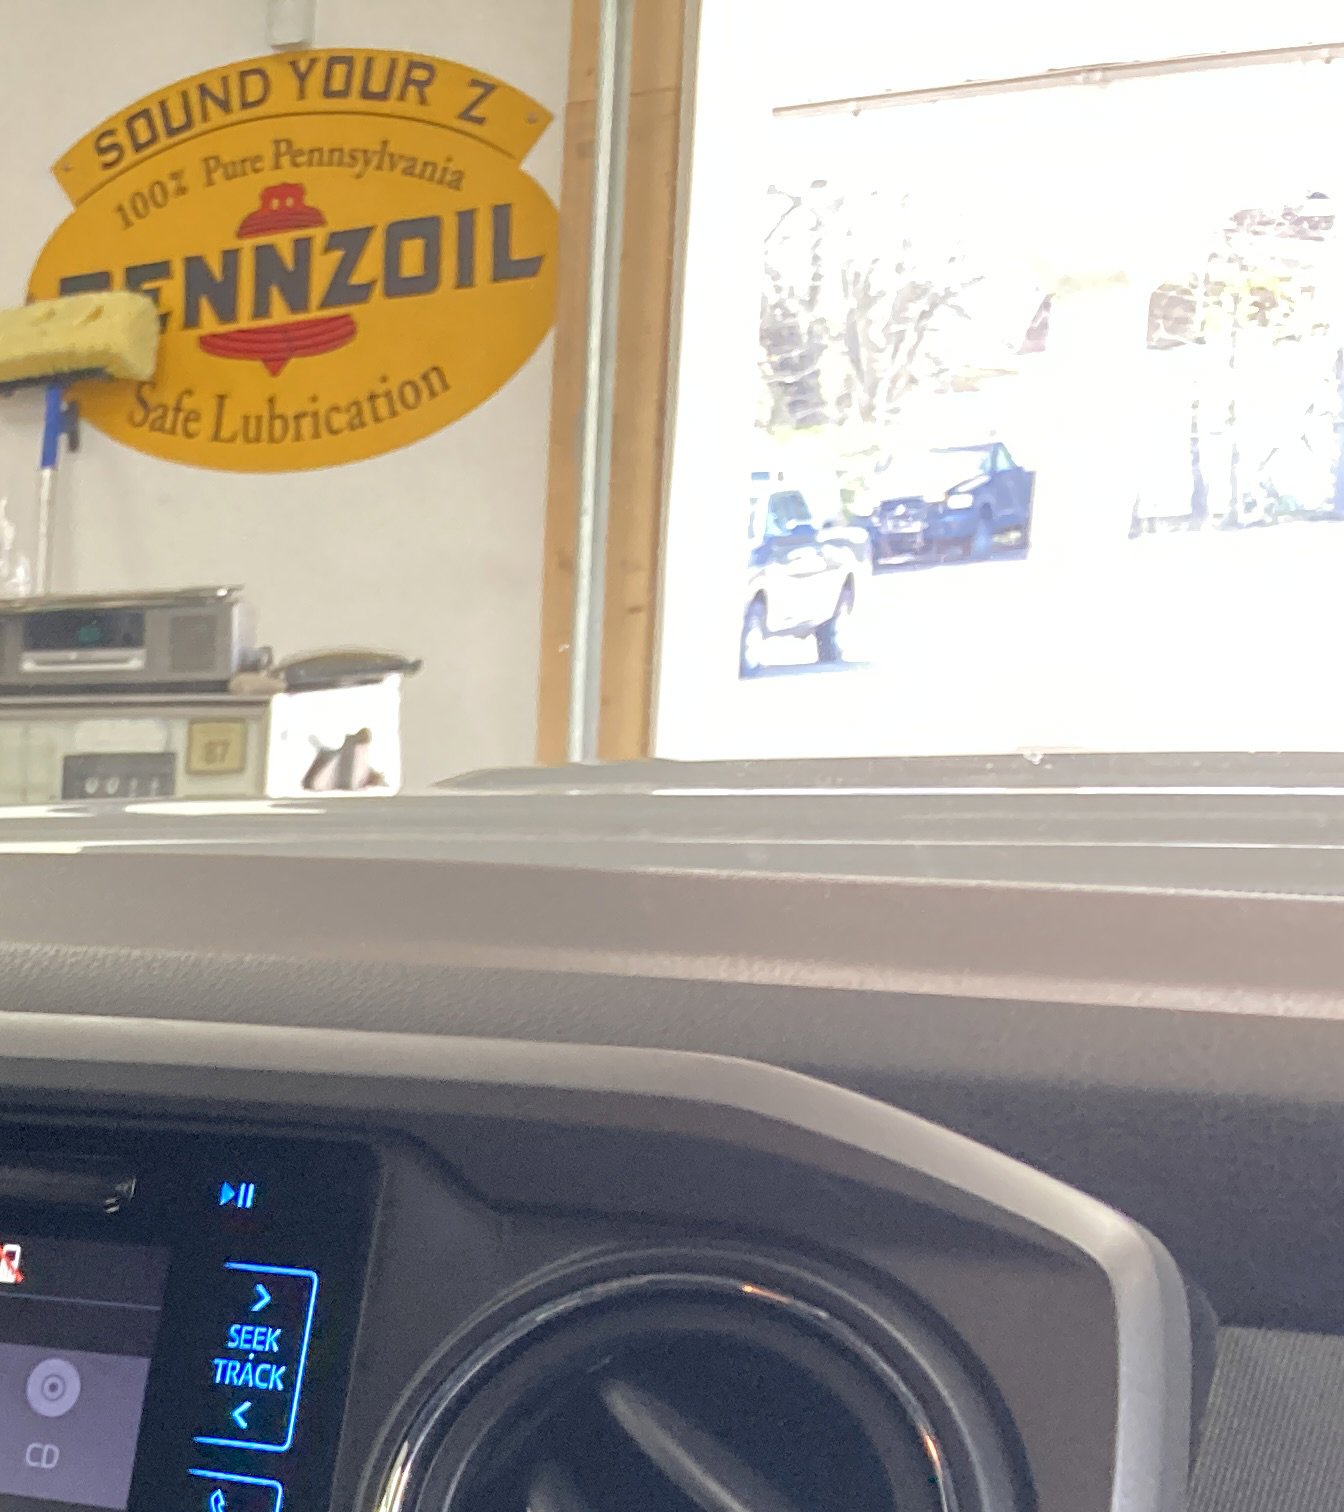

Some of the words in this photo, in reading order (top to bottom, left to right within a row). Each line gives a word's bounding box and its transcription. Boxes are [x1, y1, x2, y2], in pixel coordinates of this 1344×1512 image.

[93, 66, 271, 171] SOUND
[290, 54, 436, 106] YOUR
[458, 78, 498, 126] Z
[202, 153, 265, 188] Pure
[272, 137, 466, 191] Pennsylvania
[127, 378, 202, 439] Safe
[210, 364, 452, 446] Lubrication
[226, 1323, 282, 1354] SEEK
[212, 1357, 287, 1391] TRACK
[25, 1442, 60, 1469] CD
